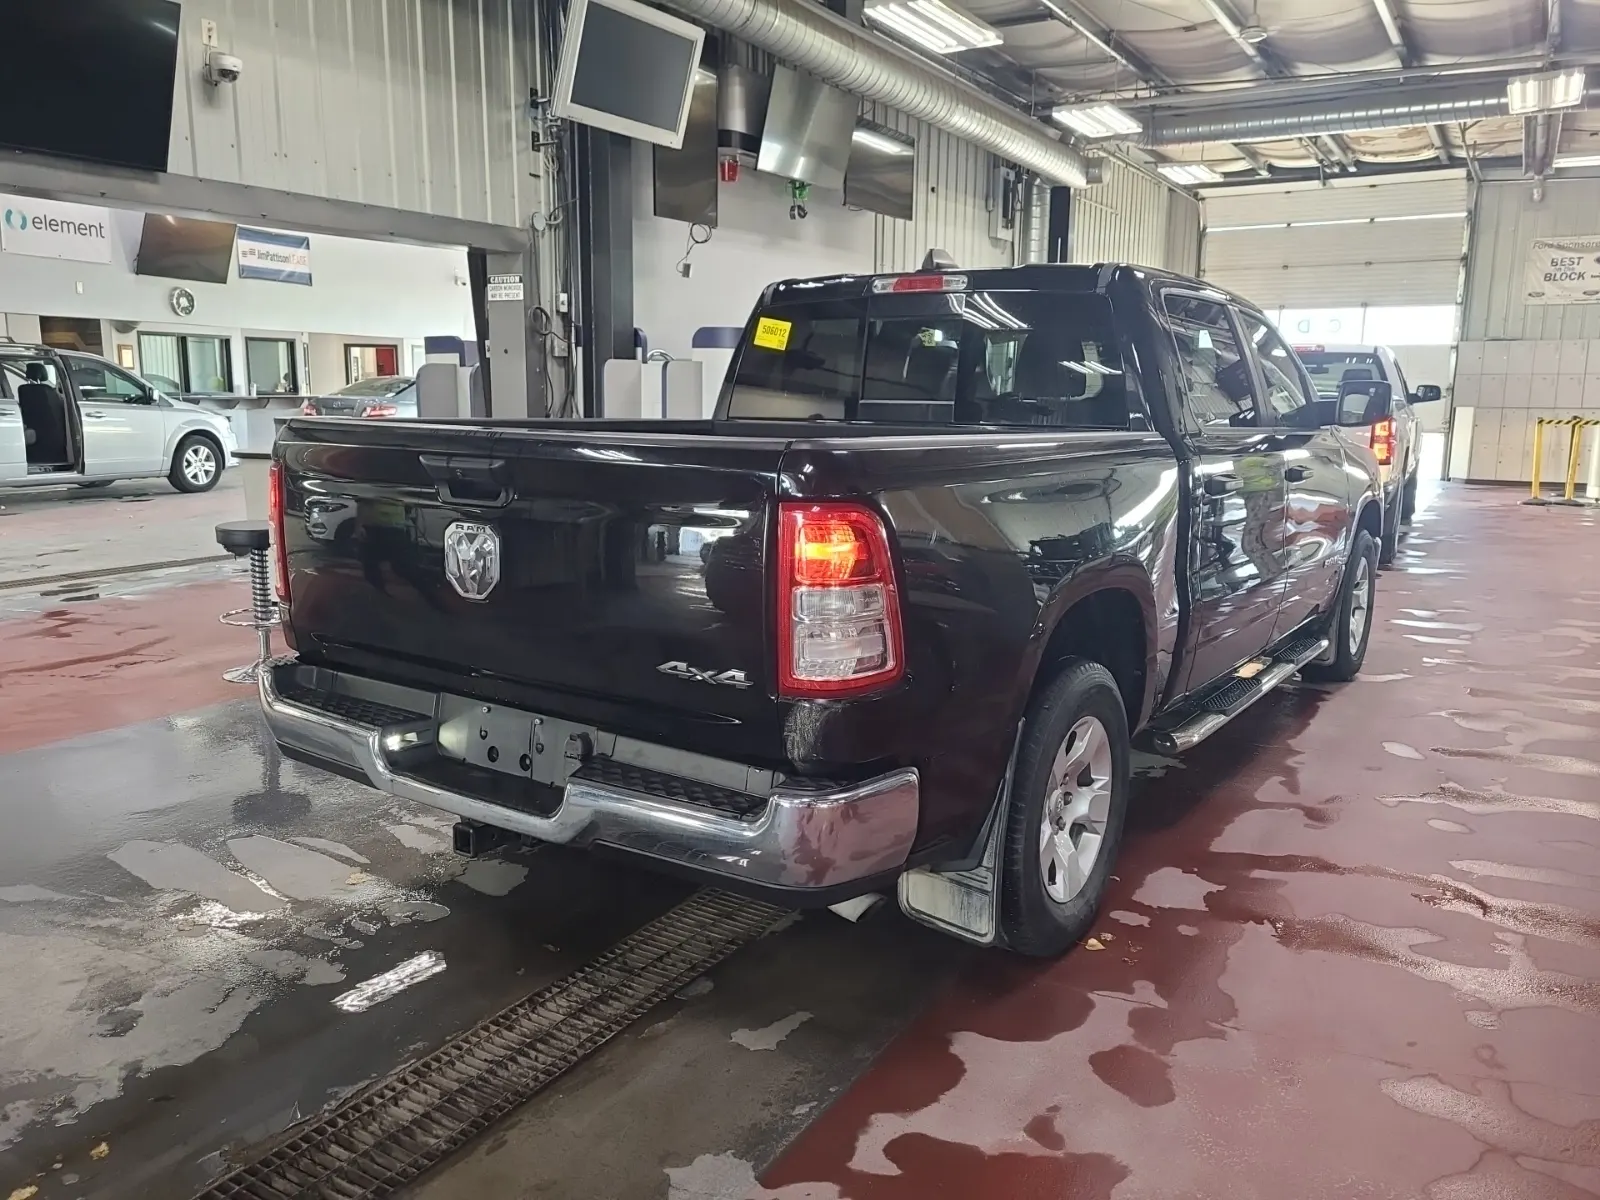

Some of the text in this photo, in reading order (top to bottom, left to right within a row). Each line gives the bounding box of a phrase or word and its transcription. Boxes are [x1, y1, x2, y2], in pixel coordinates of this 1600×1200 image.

[32, 214, 105, 239] element
[1533, 241, 1553, 250] Ford
[1550, 256, 1584, 267] BEST
[490, 275, 520, 284] CAUTION
[1543, 271, 1586, 282] BLOCK
[762, 324, 787, 338] 506012
[455, 523, 486, 533] RAM
